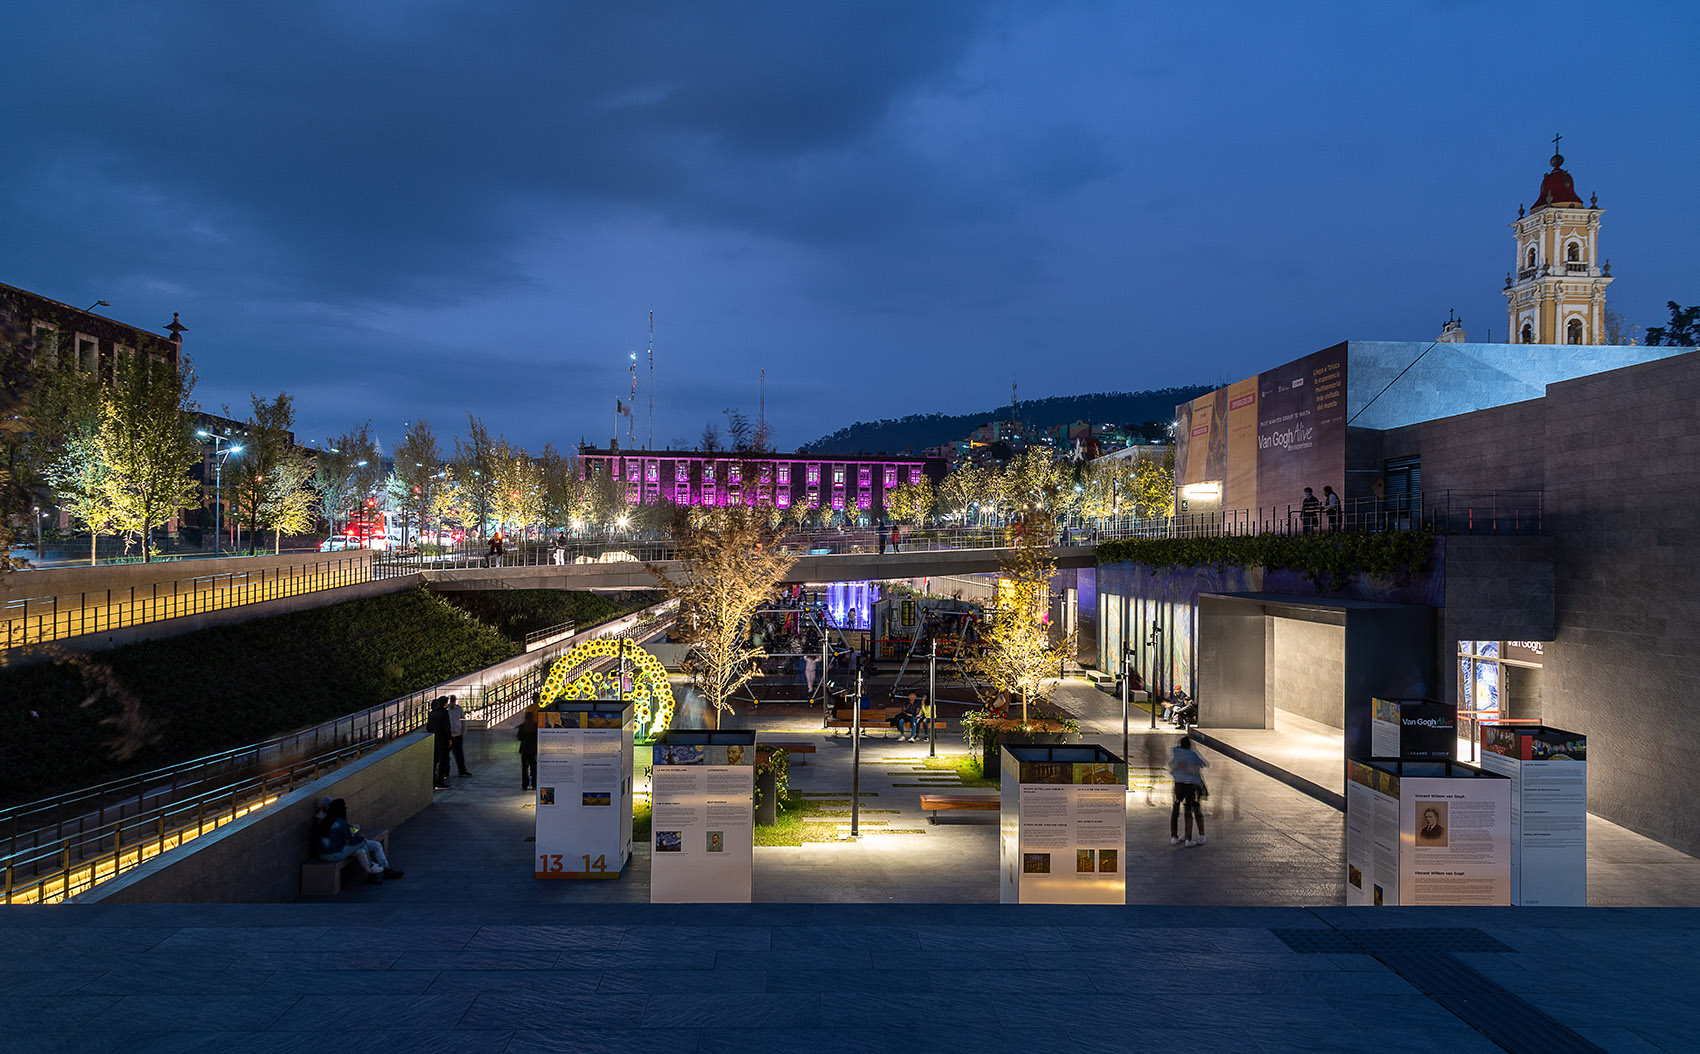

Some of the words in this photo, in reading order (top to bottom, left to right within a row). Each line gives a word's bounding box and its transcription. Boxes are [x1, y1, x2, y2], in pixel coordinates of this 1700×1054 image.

[1327, 362, 1340, 371] Toluca
[1318, 371, 1340, 383] experiencia
[1324, 400, 1337, 409] mundo
[1258, 434, 1271, 449] Van
[1272, 428, 1294, 448] Gogh
[1293, 421, 1313, 442] Alive
[1402, 718, 1416, 726] Van
[1416, 718, 1437, 727] Gogh
[540, 855, 563, 872] 13
[582, 855, 607, 872] 14
